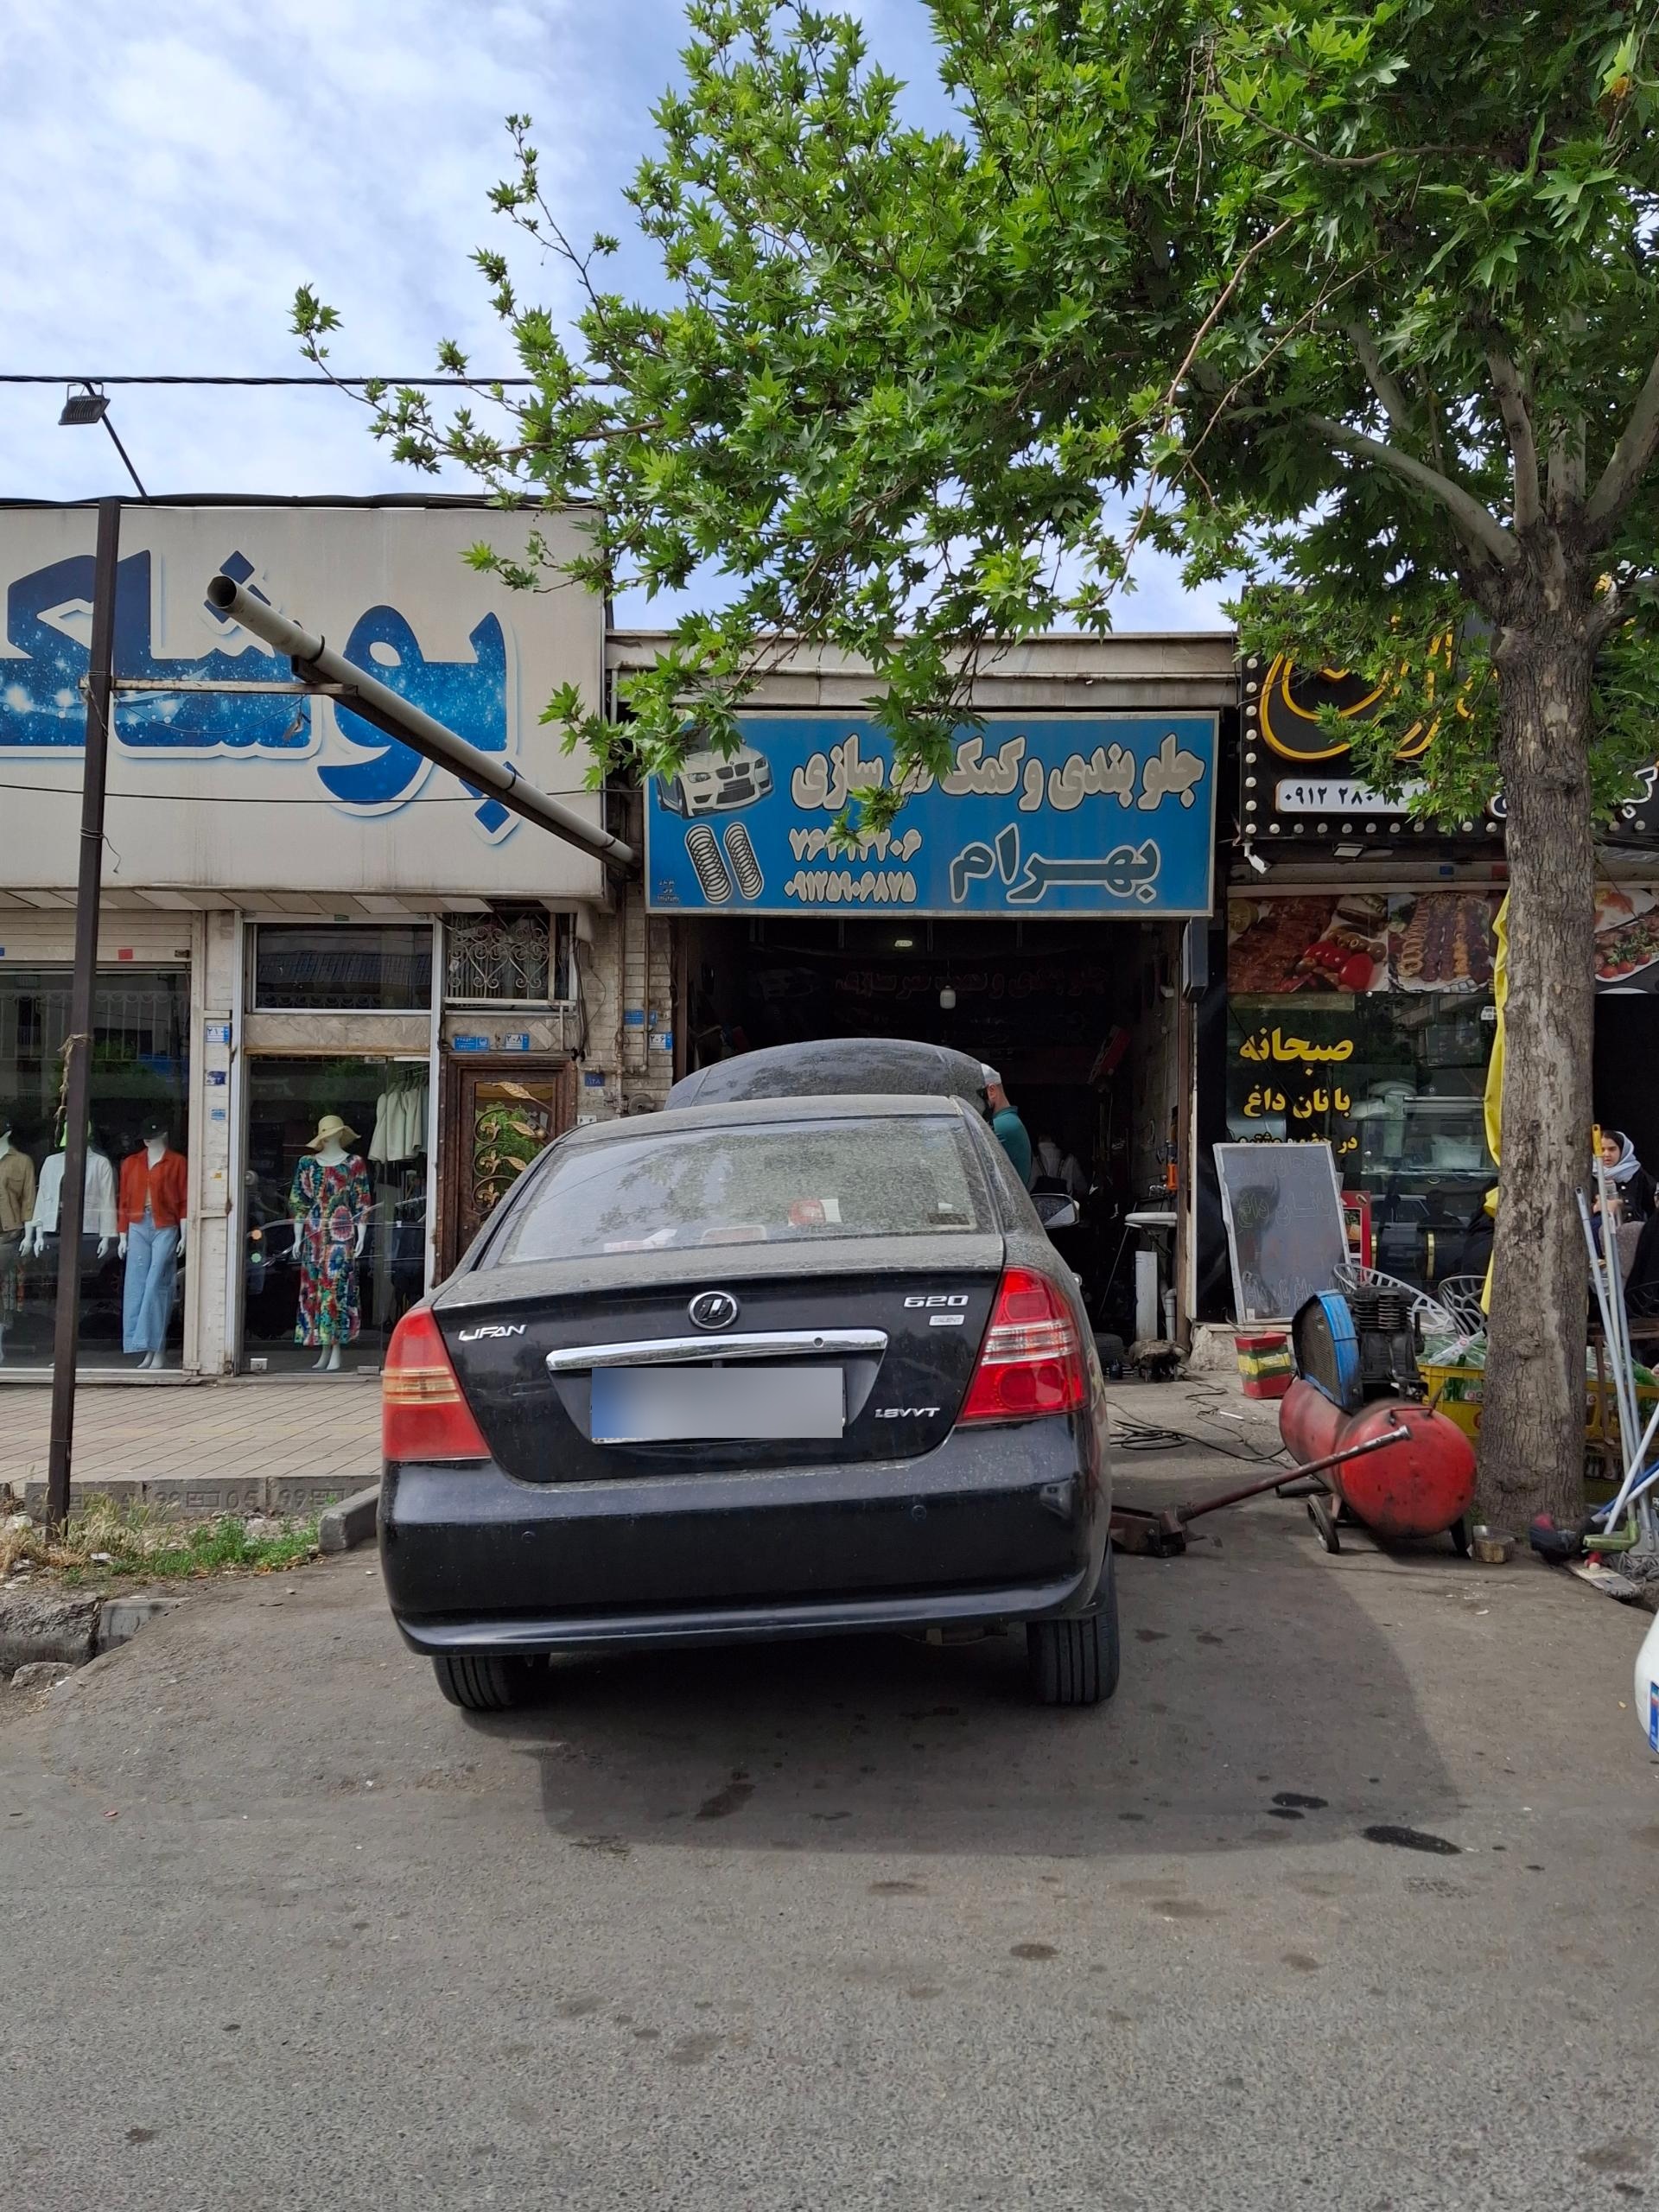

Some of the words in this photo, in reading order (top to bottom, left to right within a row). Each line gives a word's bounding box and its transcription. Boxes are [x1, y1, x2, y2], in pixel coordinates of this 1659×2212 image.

[1018, 757, 1044, 812] و
[1285, 785, 1327, 805] ۰۹۱۲
[950, 821, 1162, 904] بهرام
[784, 869, 918, 903] ۰۹۱۲۵۹۰۶۸۷۵
[1239, 1027, 1354, 1076] صبحانه
[1243, 1084, 1286, 1117] داغ
[1293, 1088, 1330, 1119] نان
[1334, 1087, 1351, 1117] با
[1337, 1136, 1357, 1154] در
[904, 1295, 969, 1307] 620
[458, 1325, 527, 1341] LIFAN
